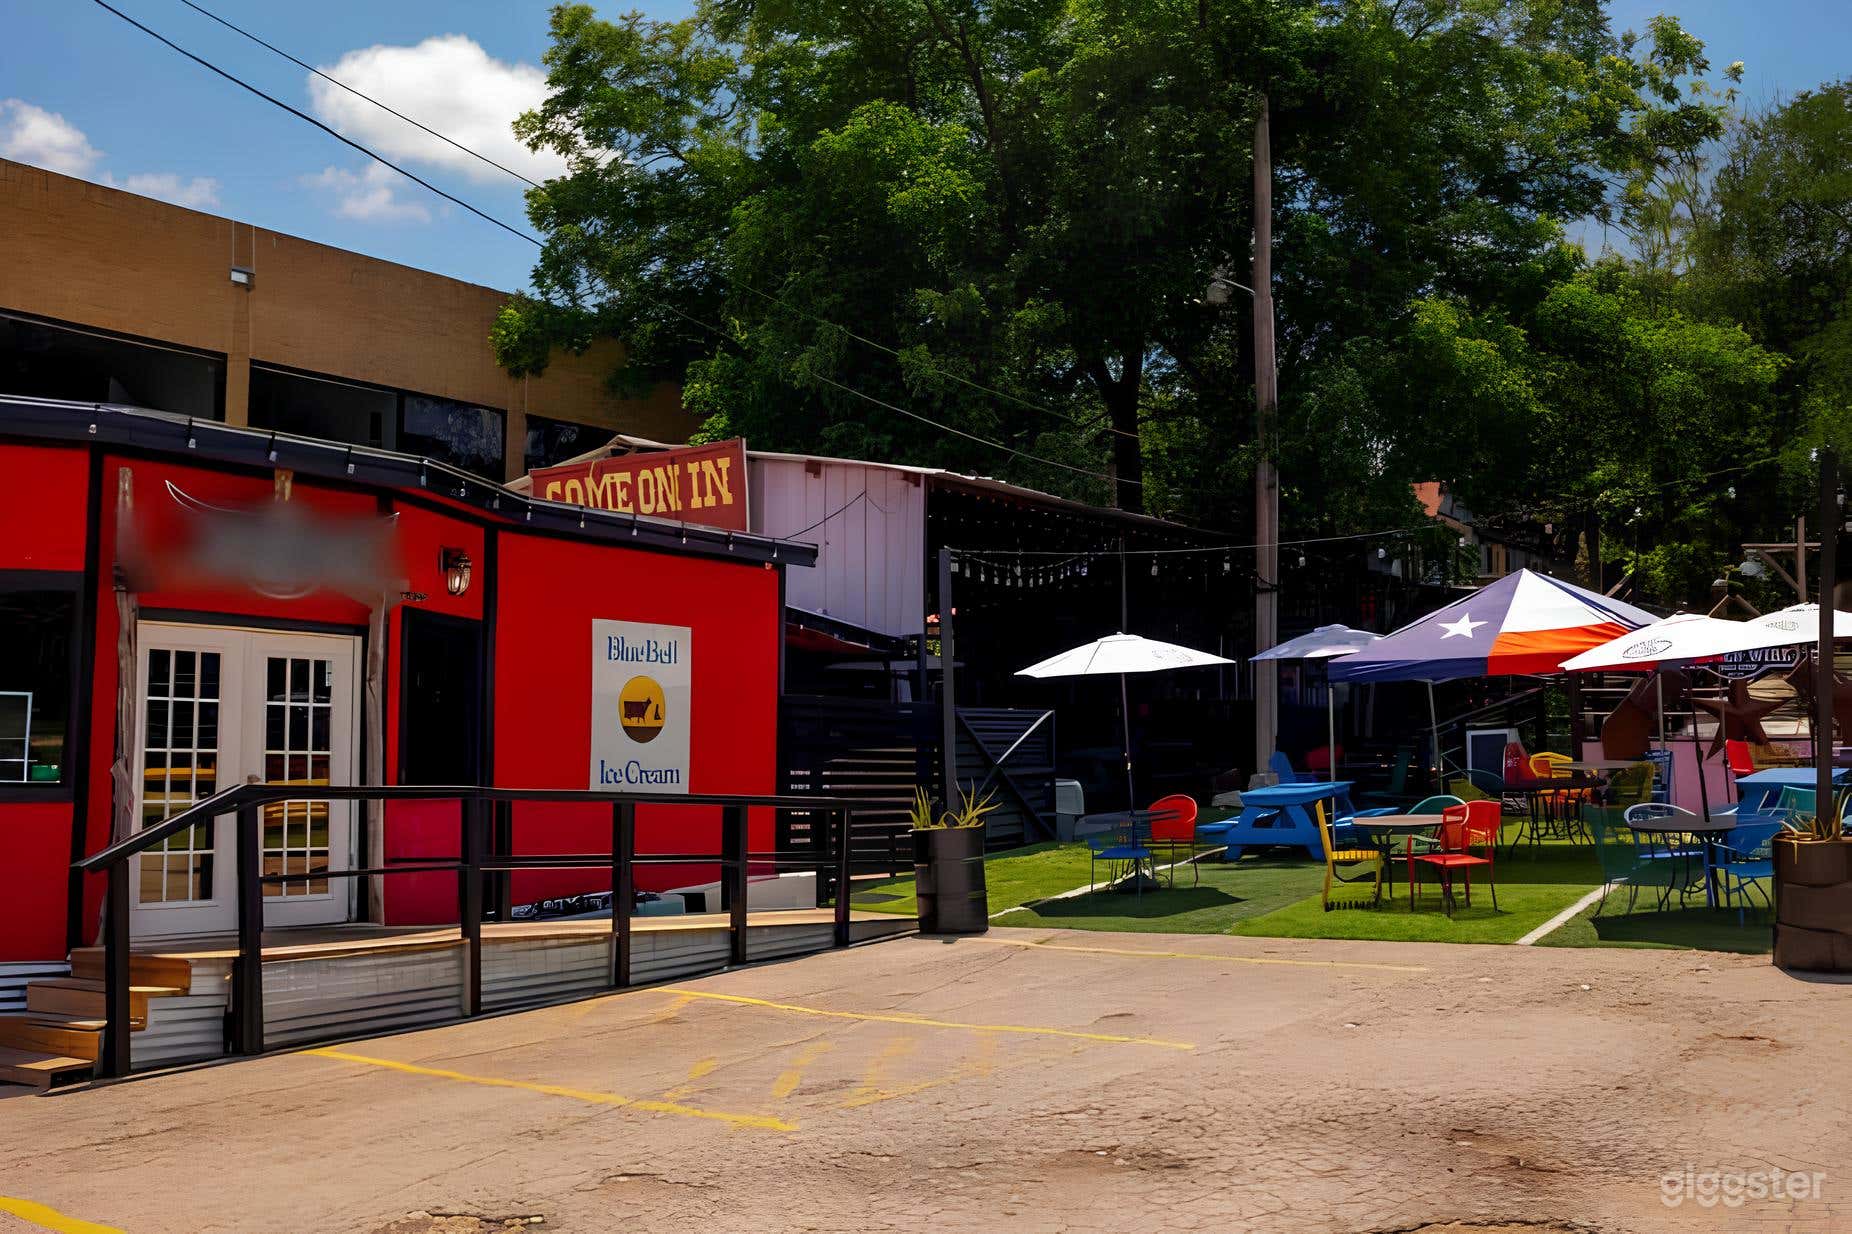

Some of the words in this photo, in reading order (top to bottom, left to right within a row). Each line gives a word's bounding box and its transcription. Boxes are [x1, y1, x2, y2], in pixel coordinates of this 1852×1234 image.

[637, 464, 682, 514] ON
[687, 457, 733, 508] IN
[607, 635, 644, 662] Blue
[646, 639, 678, 664] Bell
[600, 759, 623, 785] Ice
[625, 760, 680, 785] Cream
